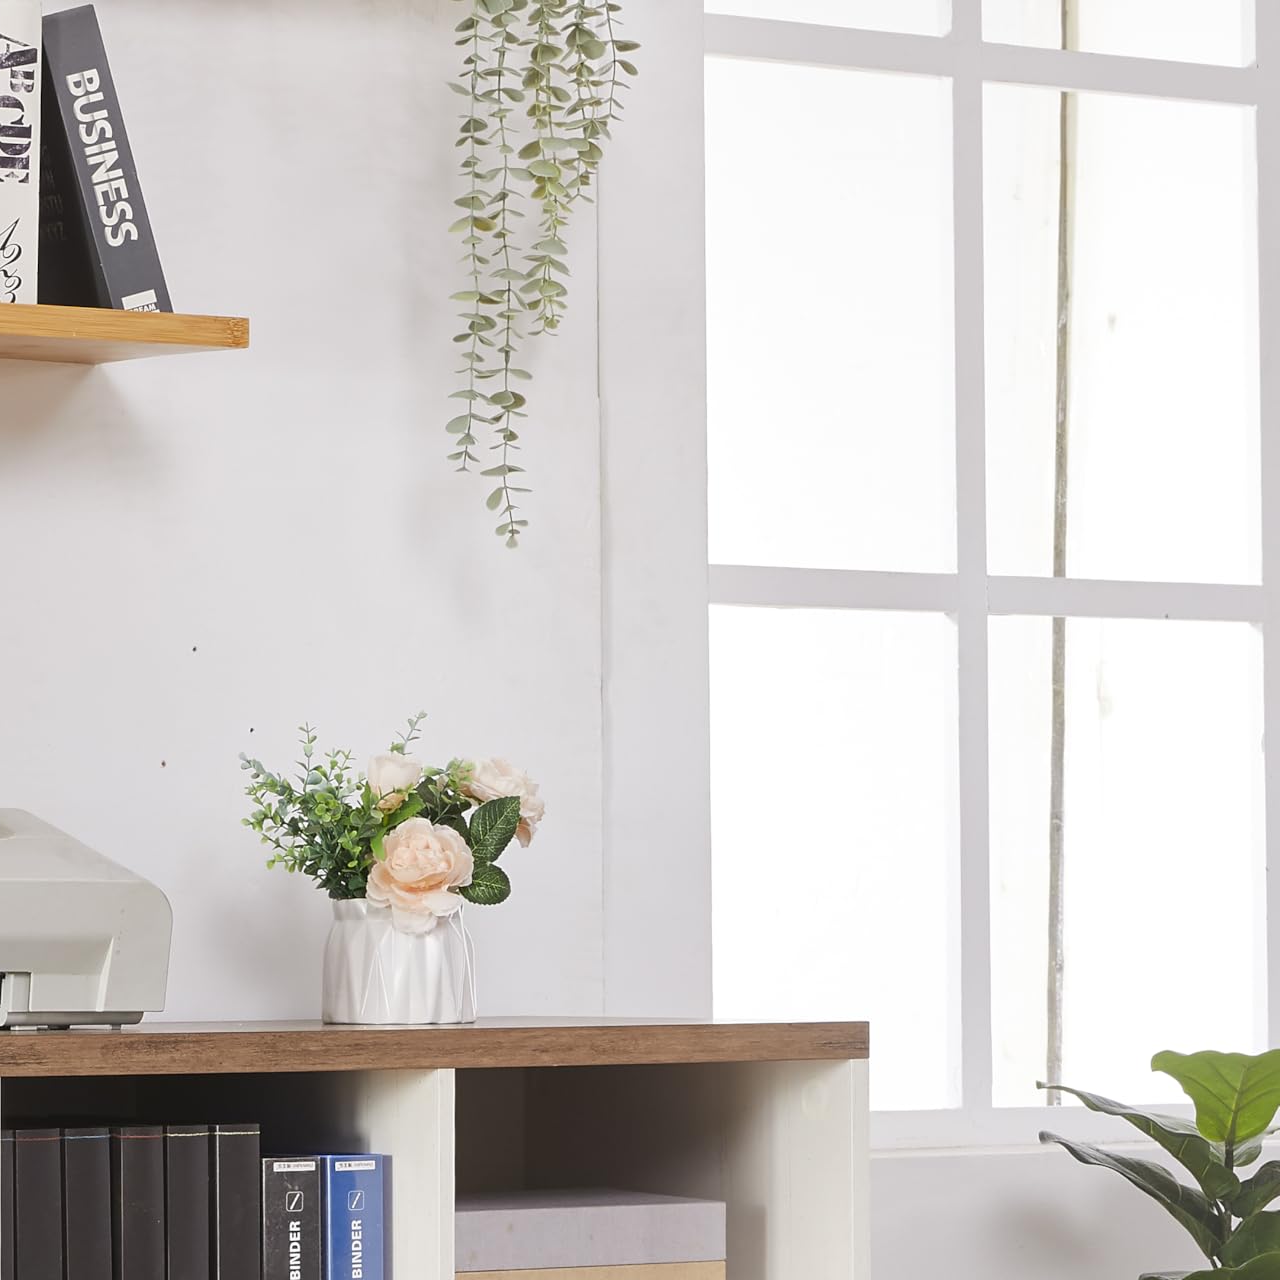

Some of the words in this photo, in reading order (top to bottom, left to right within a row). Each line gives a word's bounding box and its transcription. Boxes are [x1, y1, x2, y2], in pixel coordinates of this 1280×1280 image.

[66, 68, 138, 247] BUSINESS
[290, 1221, 301, 1280] BINDER
[352, 1220, 362, 1278] BINDER
